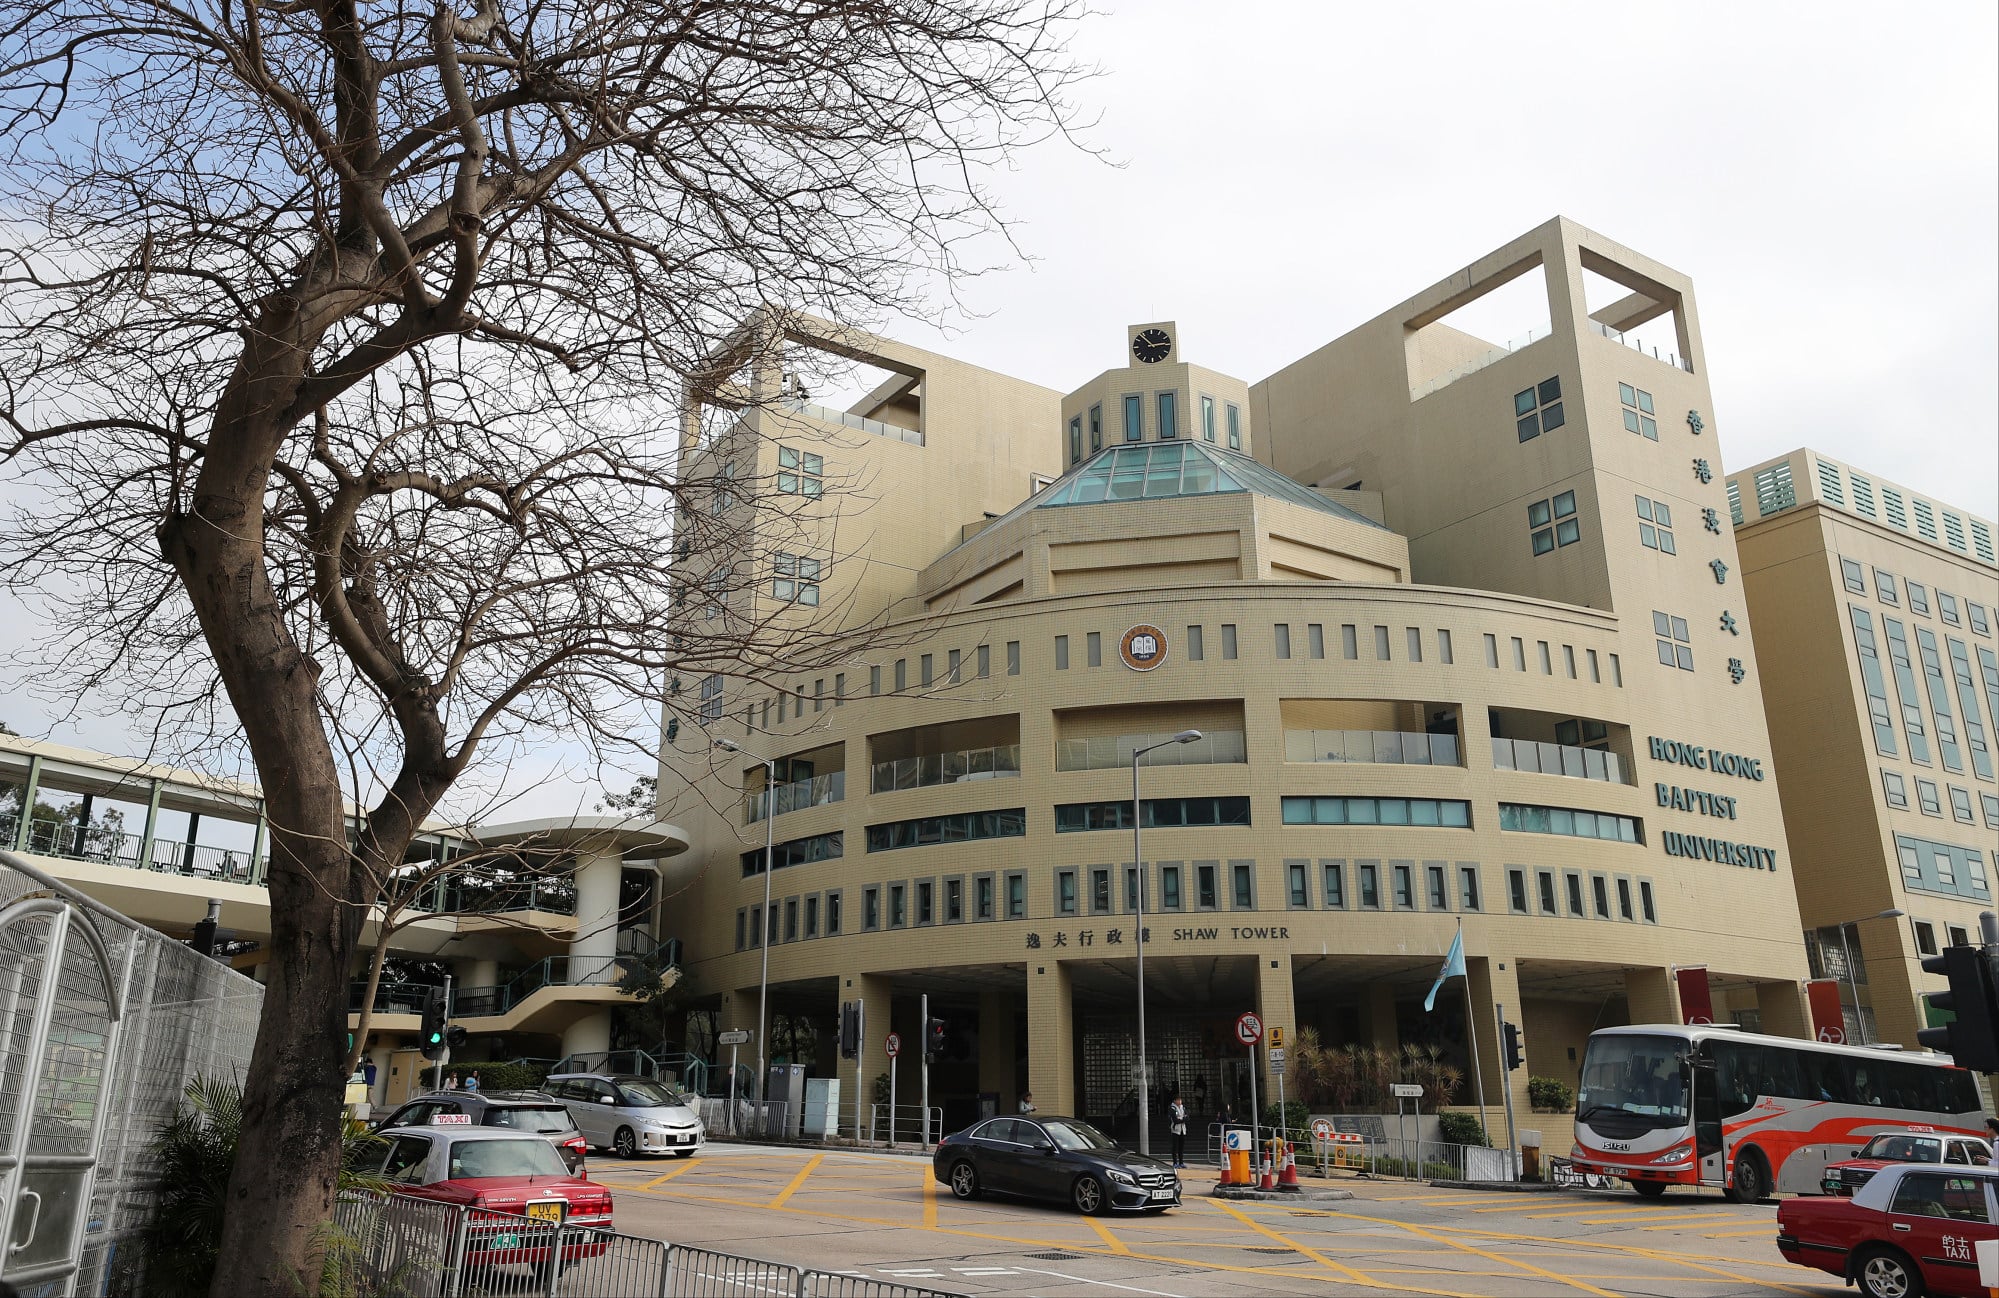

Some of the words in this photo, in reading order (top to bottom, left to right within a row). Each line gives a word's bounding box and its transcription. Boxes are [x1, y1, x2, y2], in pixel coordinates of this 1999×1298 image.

[1687, 409, 1745, 684] 香港浸會大學
[1648, 735, 1707, 769] HONG
[1708, 748, 1764, 781] KONG
[1656, 782, 1737, 819] BAPTIST
[1663, 830, 1777, 872] UNIVERSITY
[1173, 928, 1218, 941] SHAW
[1231, 927, 1290, 940] TOWER
[438, 1115, 468, 1124] TAXI
[1602, 1142, 1630, 1151] ISUZU
[538, 1204, 551, 1213] UV
[1942, 1234, 1969, 1248] 的士
[1942, 1246, 1970, 1260] TAXI
